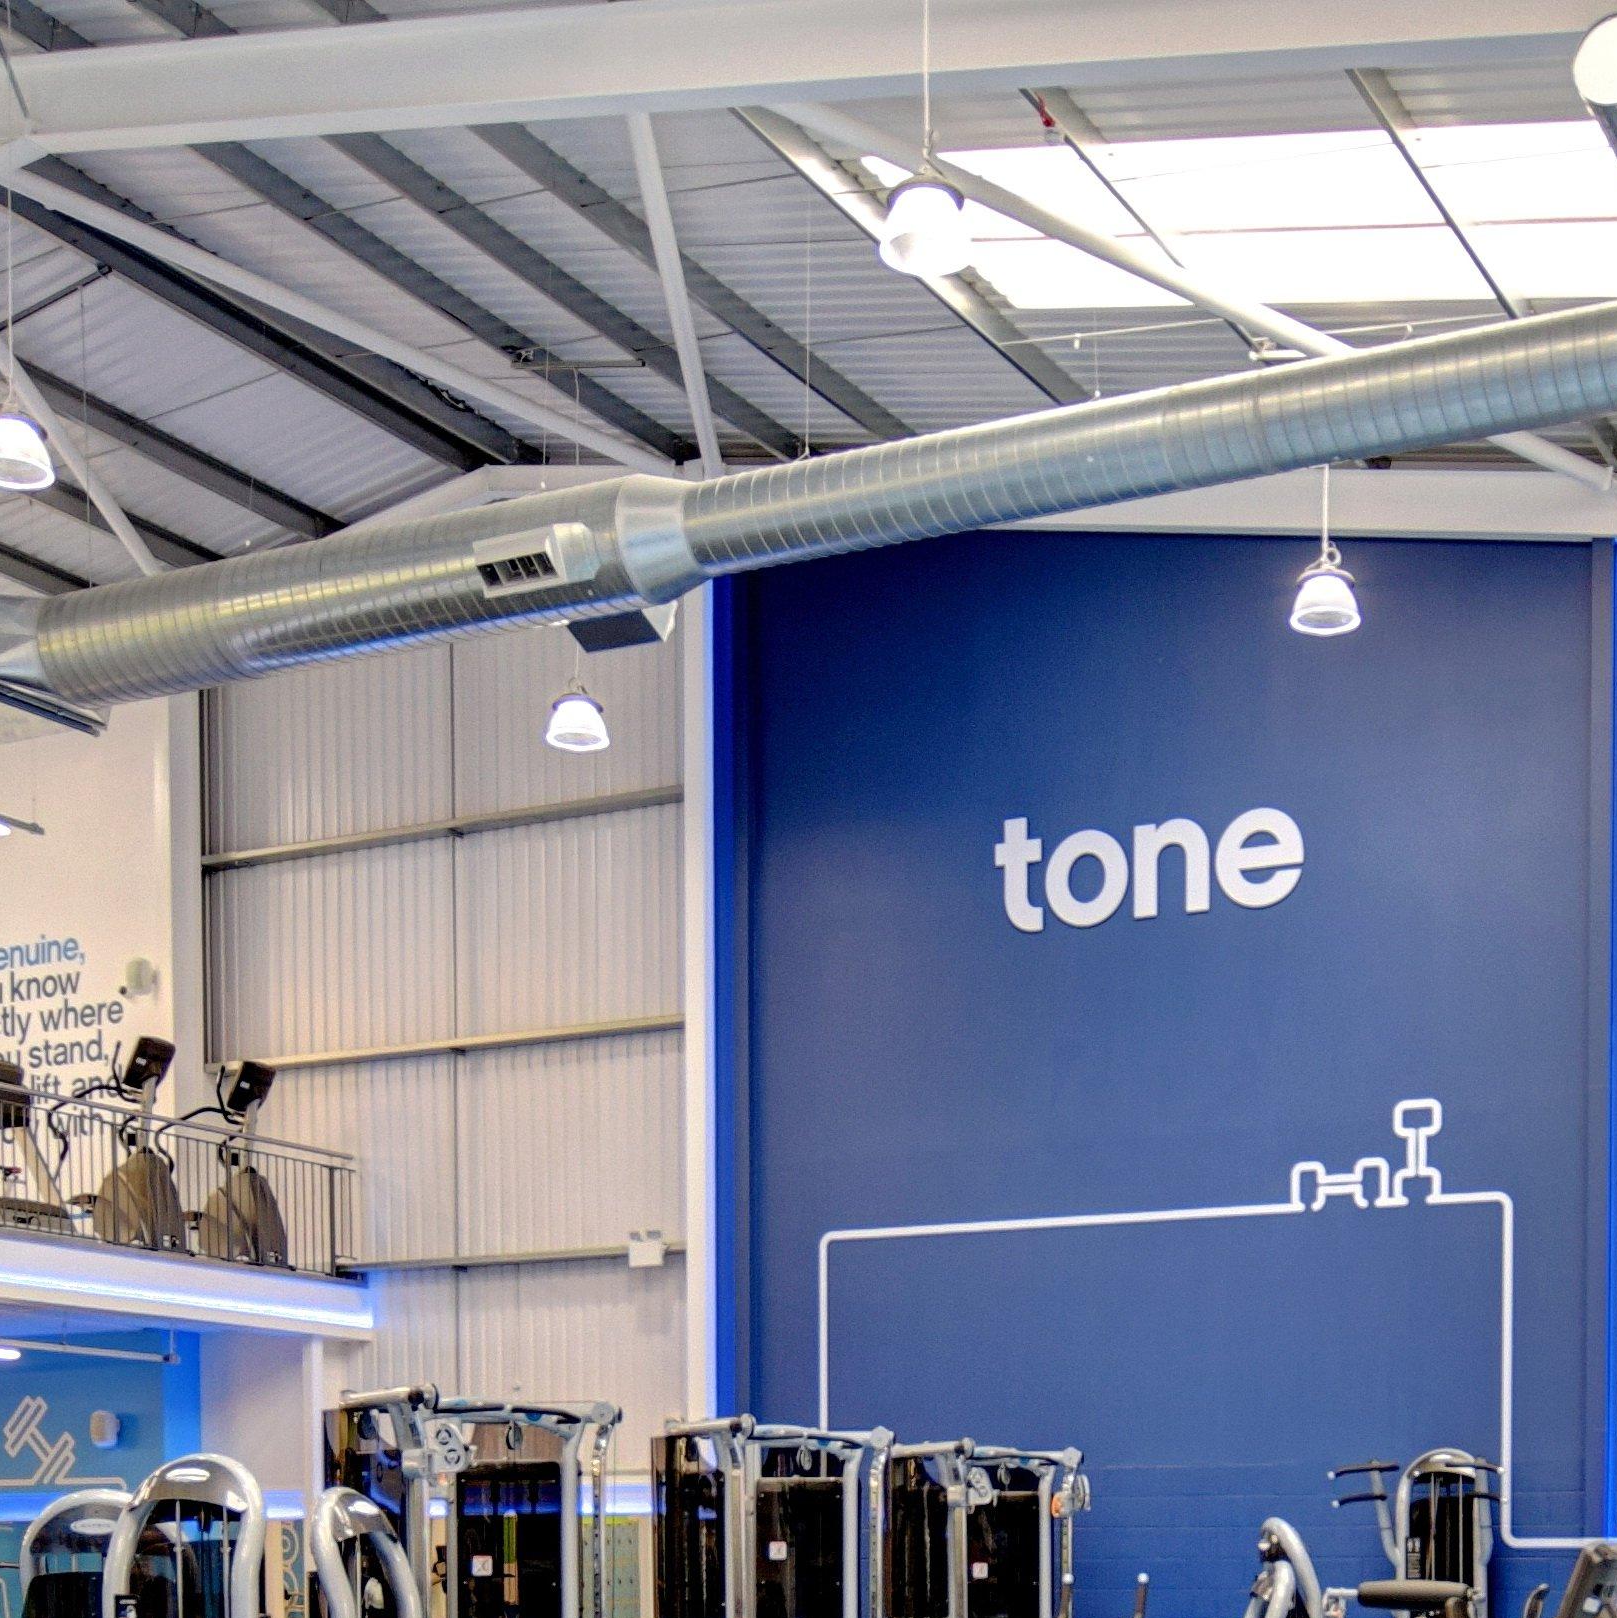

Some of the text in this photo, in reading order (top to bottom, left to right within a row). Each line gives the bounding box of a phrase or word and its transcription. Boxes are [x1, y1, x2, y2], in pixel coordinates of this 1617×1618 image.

[994, 807, 1305, 932] tone
[10, 971, 81, 1003] know
[39, 998, 124, 1033] where
[28, 1029, 109, 1069] stand,
